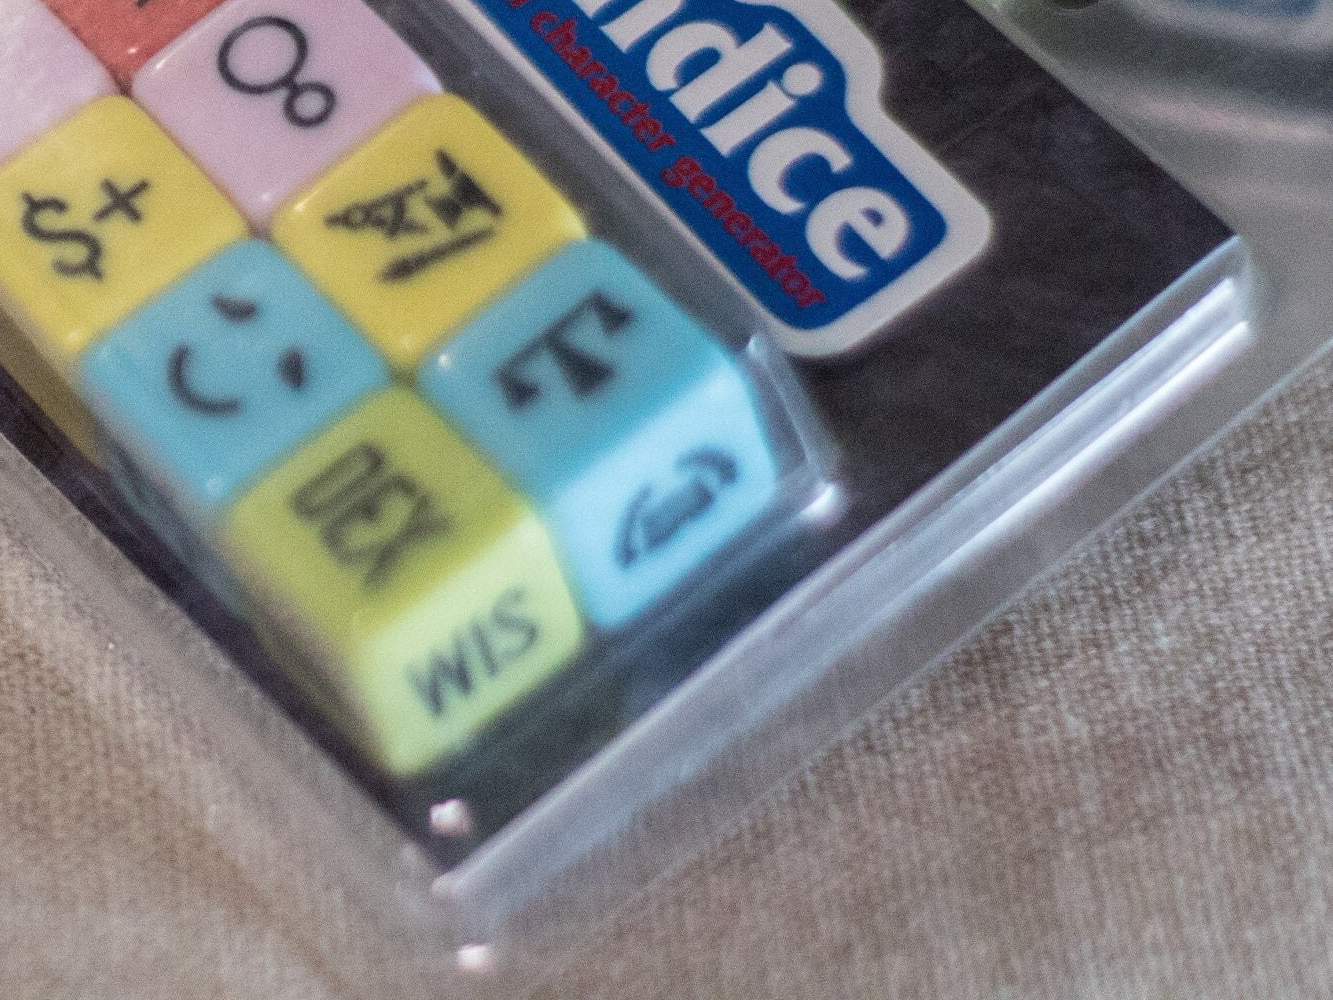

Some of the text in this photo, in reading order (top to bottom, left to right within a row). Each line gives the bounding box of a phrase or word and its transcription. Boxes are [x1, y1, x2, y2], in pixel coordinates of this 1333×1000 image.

[531, 11, 676, 152] character
[660, 156, 828, 308] generator
[288, 441, 455, 592] DEX
[404, 585, 541, 721] WIS
